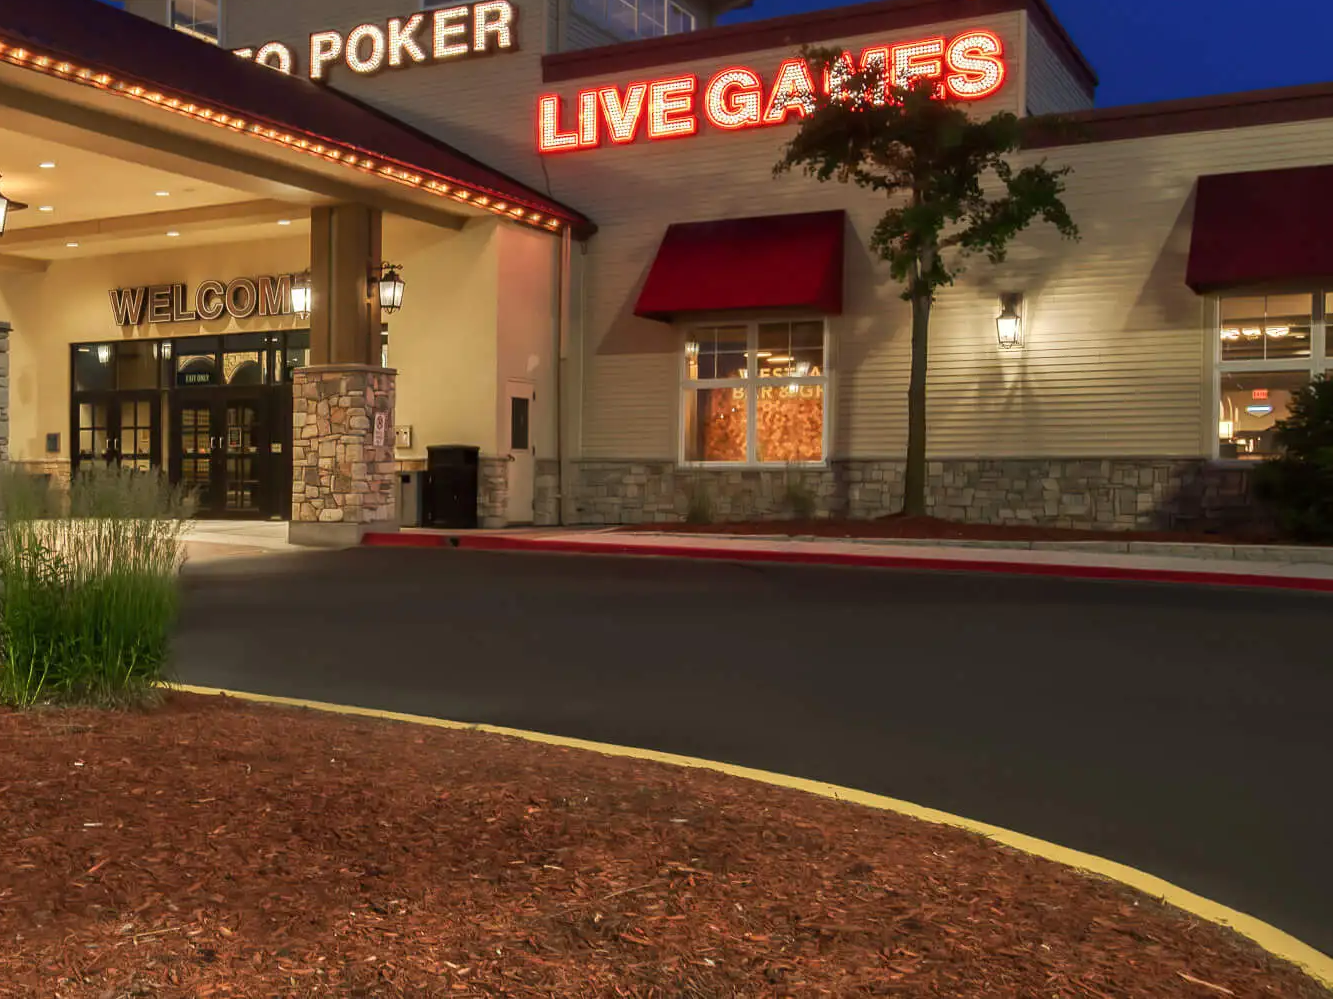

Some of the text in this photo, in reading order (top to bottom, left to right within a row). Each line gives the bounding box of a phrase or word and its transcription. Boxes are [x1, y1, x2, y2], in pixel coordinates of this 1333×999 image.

[231, 0, 513, 80] O POKER
[537, 72, 698, 154] LIVE
[108, 274, 309, 326] WELCOM
